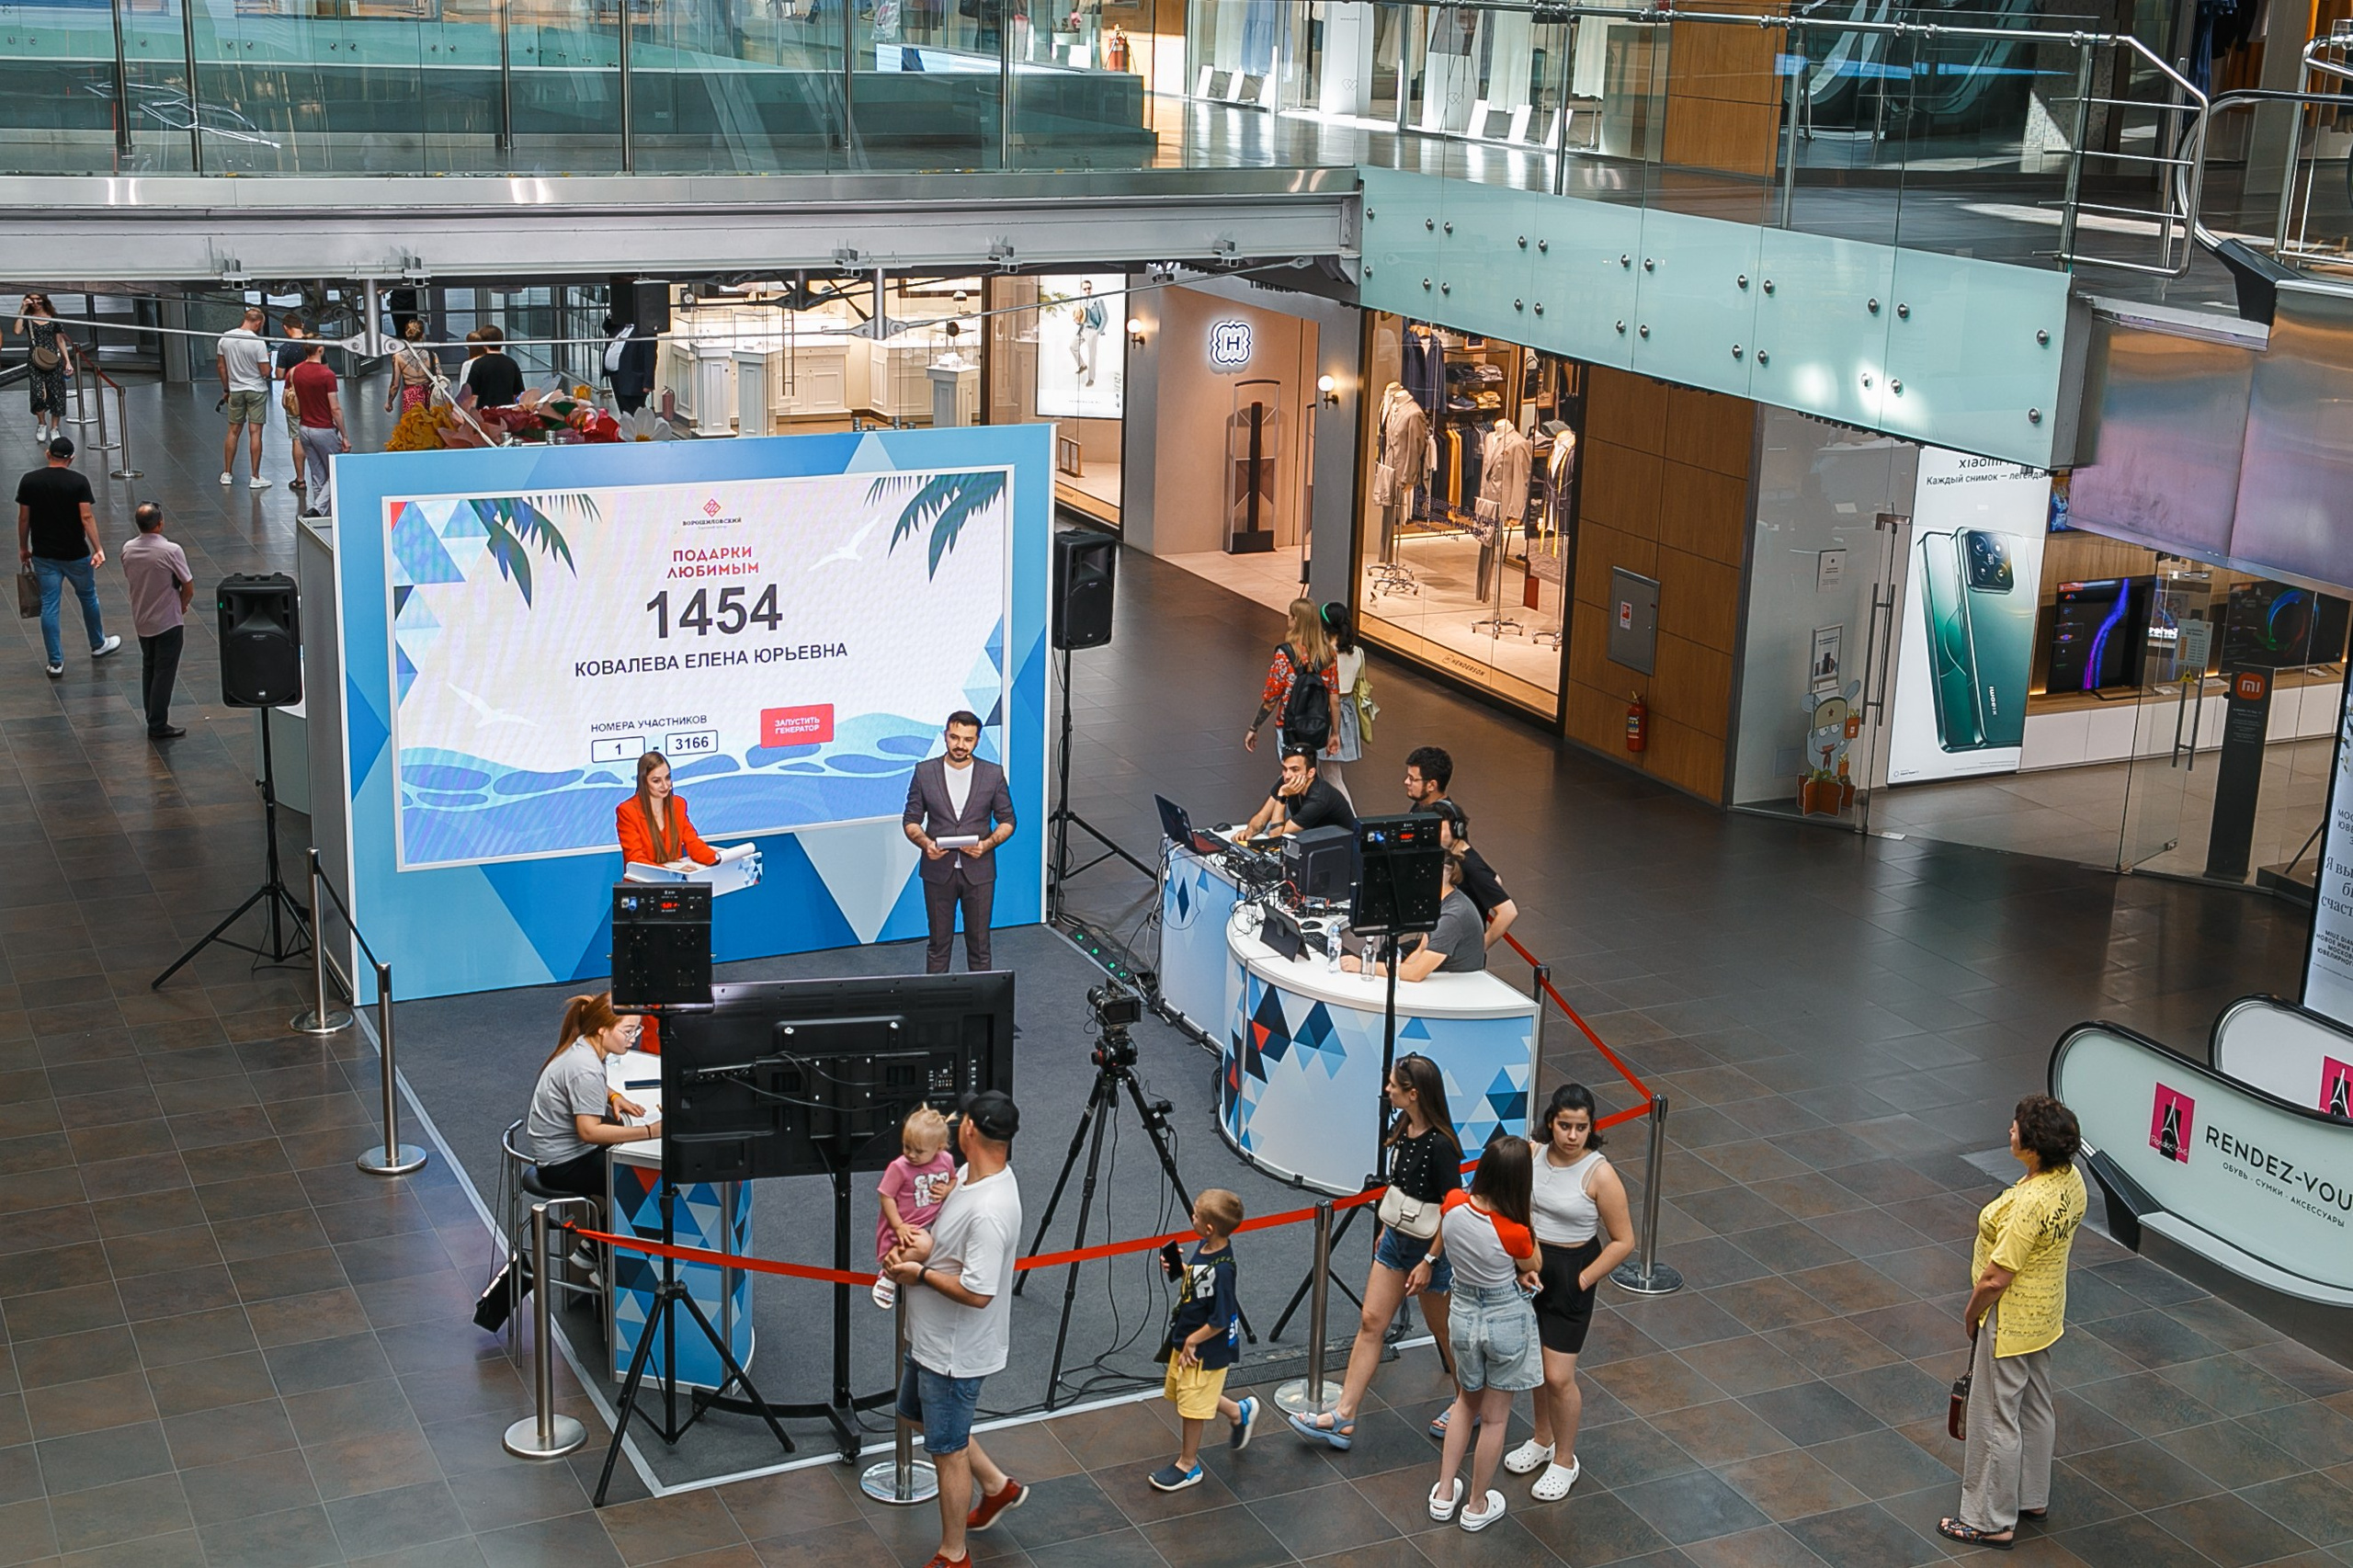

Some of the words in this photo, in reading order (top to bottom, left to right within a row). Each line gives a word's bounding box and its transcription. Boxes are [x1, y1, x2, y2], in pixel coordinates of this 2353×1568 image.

[1227, 335, 1240, 351] H
[1927, 473, 1963, 485] Каждый
[1965, 472, 1998, 483] снимок
[683, 517, 742, 526] ВОРОШИЛОВСКИЙ
[673, 546, 752, 562] ПОДАРКИ
[667, 562, 758, 578] ЛЮБИМЫМ
[647, 584, 783, 639] 1454
[574, 655, 679, 677] КОВАЛЕВА
[685, 650, 748, 669] ЕЛЕНА
[755, 642, 847, 664] ЮРЬЕВНА
[1451, 659, 1485, 676] HENDERSON
[1989, 686, 1997, 715] xiaomi
[591, 721, 635, 733] НОМЕРА
[638, 715, 708, 729] УЧАСТНИКОВ
[775, 717, 820, 727] ЗАПУСТИТЬ
[775, 724, 820, 734] ГЕНЕРАТОР
[615, 744, 621, 755] 1
[676, 736, 709, 750] 3166
[2325, 856, 2334, 870] Я
[2316, 934, 2336, 945] НОВОЕ
[2325, 929, 2339, 940] MIUZ
[2317, 948, 2353, 966] ЮВЕЛИРНОГ
[2328, 945, 2353, 960] МОСКОВ
[2222, 1162, 2248, 1180] ОБУВЬ
[2256, 1178, 2283, 1198] СУМКИ
[2290, 1196, 2345, 1228] АКСЕССУАРЫ
